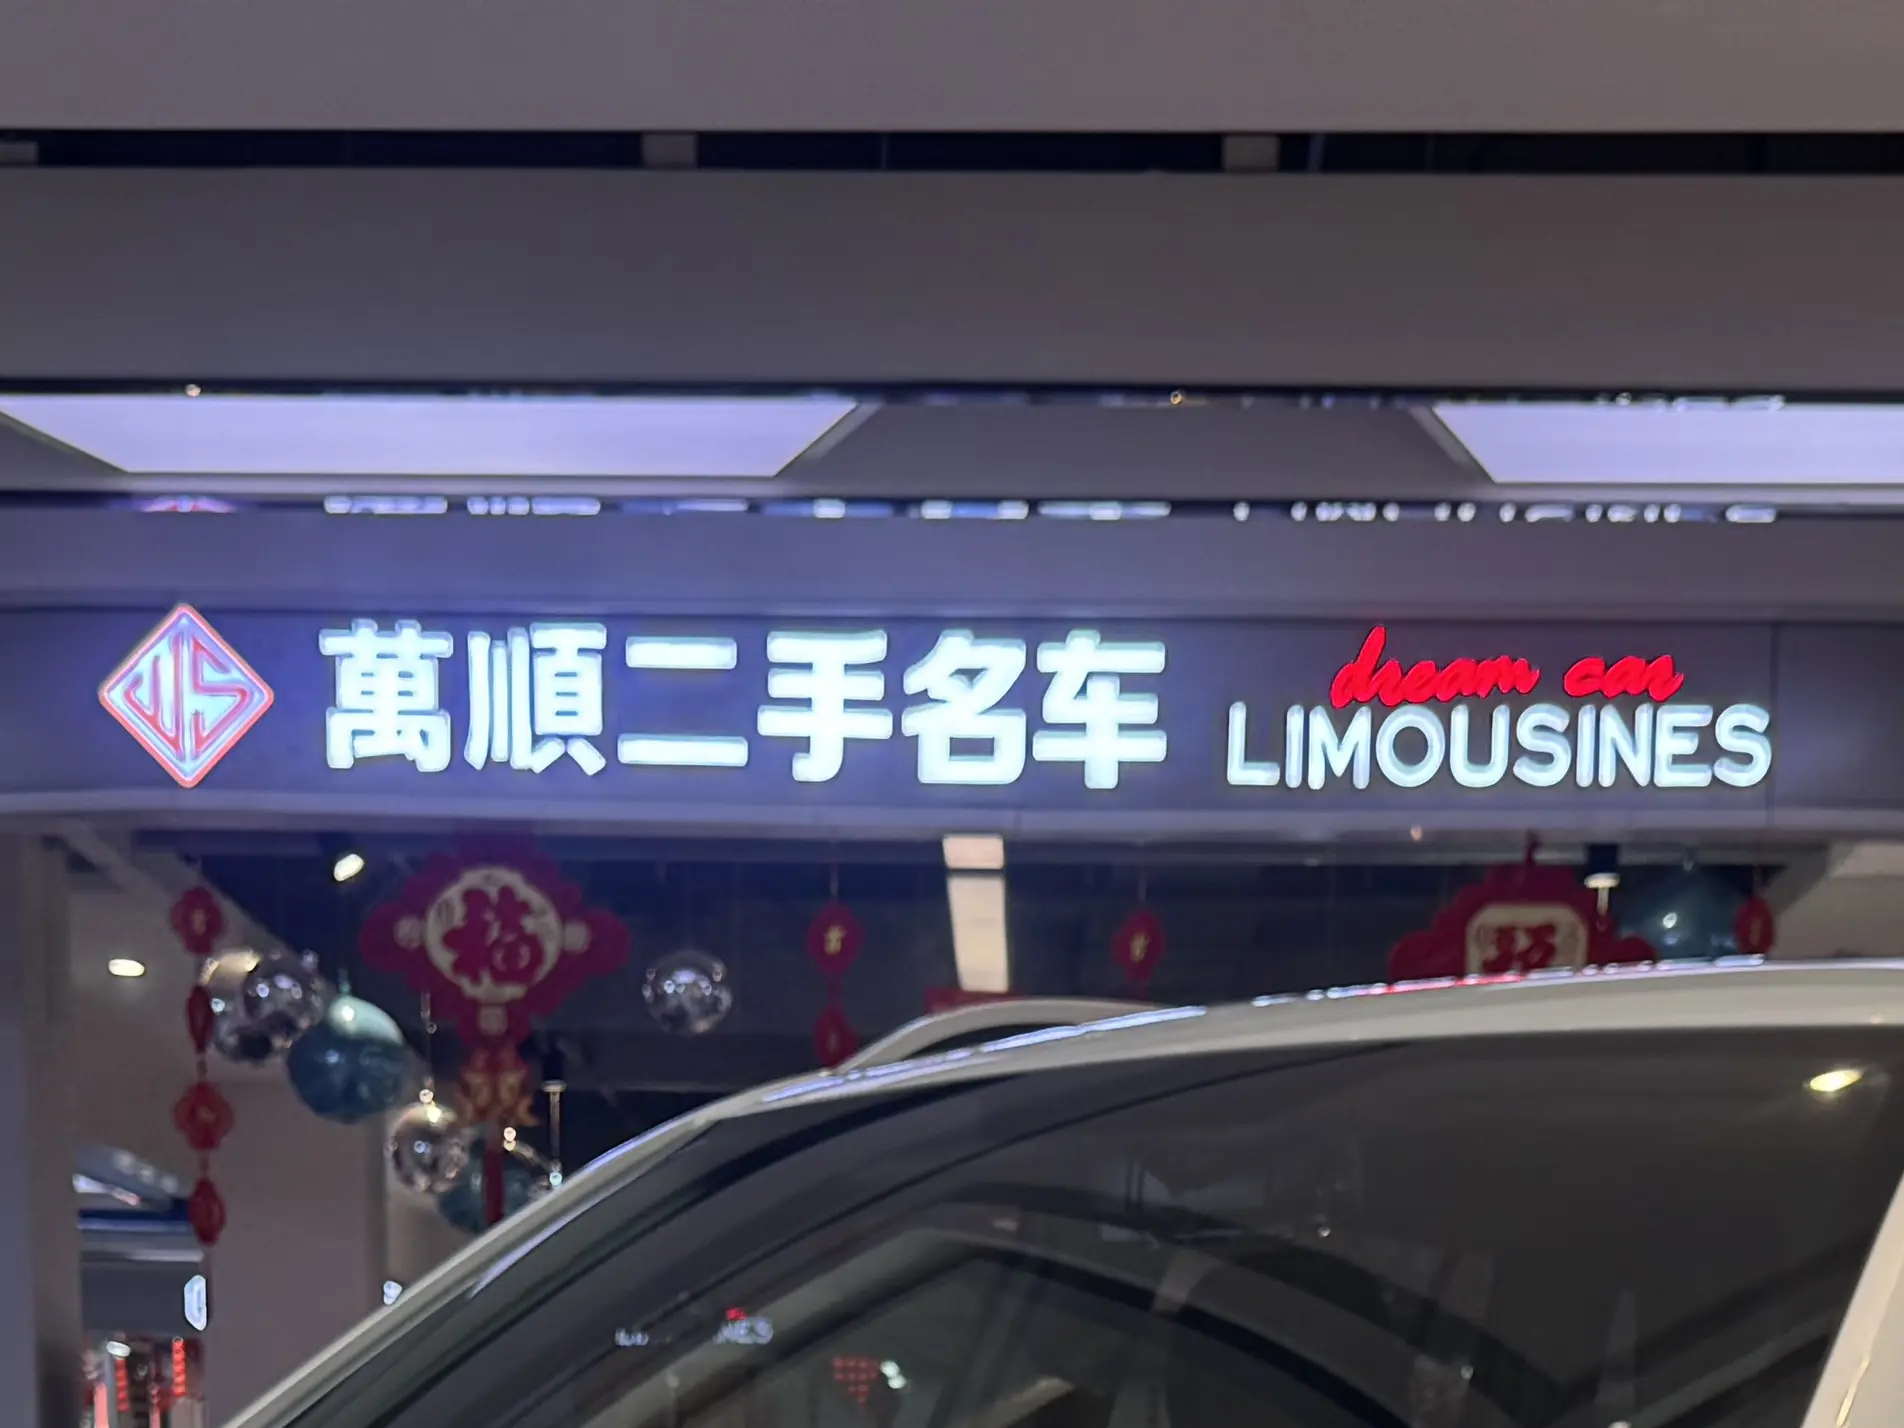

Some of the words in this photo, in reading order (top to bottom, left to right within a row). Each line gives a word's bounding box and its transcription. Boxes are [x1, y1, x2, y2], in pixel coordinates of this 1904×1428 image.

[318, 618, 1168, 790] 萬順二手名车
[1330, 624, 1540, 708] dream
[1226, 701, 1773, 790] LIMOUSINES
